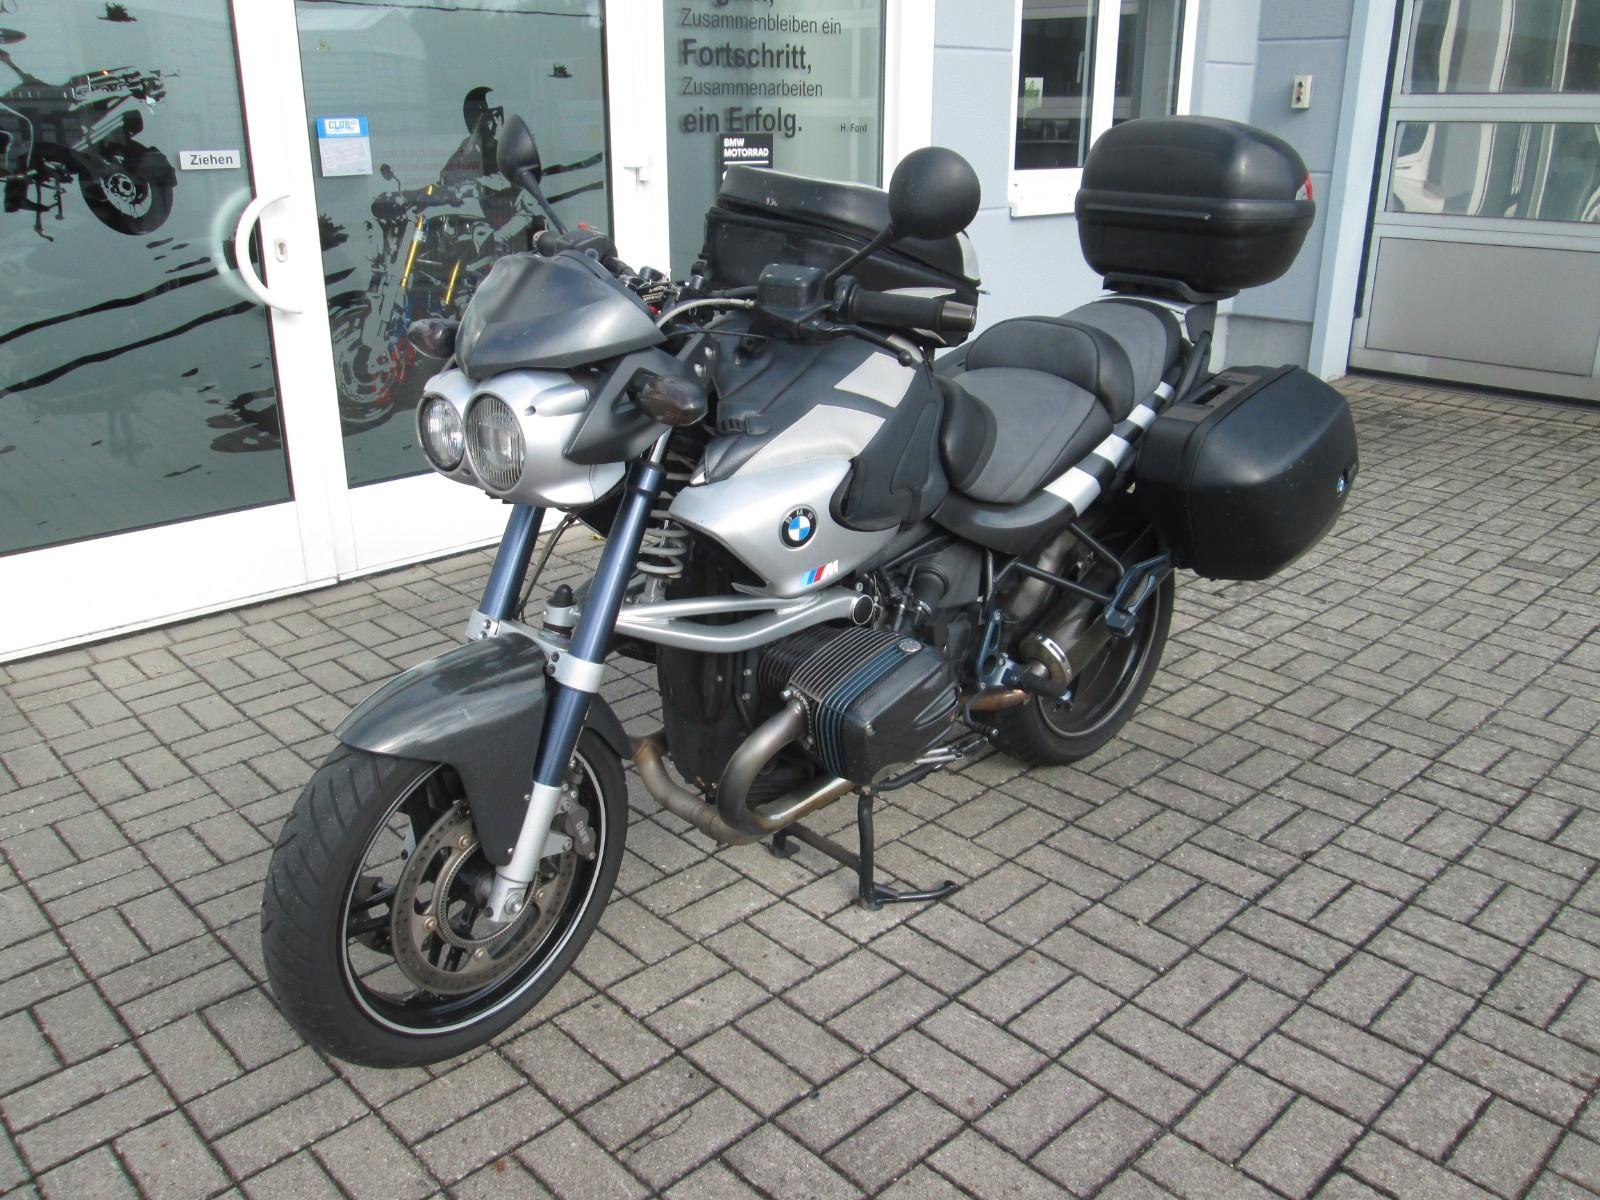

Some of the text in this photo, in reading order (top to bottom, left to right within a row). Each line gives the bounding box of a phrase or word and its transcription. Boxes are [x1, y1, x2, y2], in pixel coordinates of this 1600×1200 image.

[681, 8, 842, 35] Zusammenbleiben ein
[681, 38, 813, 74] Fortschritt,
[681, 76, 823, 97] Zusammenarbeiten
[682, 107, 803, 138] ein Erfolg.
[840, 123, 868, 133] H. Ford
[723, 137, 745, 147] BMW
[190, 154, 234, 166] Ziehen
[723, 147, 770, 158] MOTORRAD
[785, 508, 814, 524] BMW
